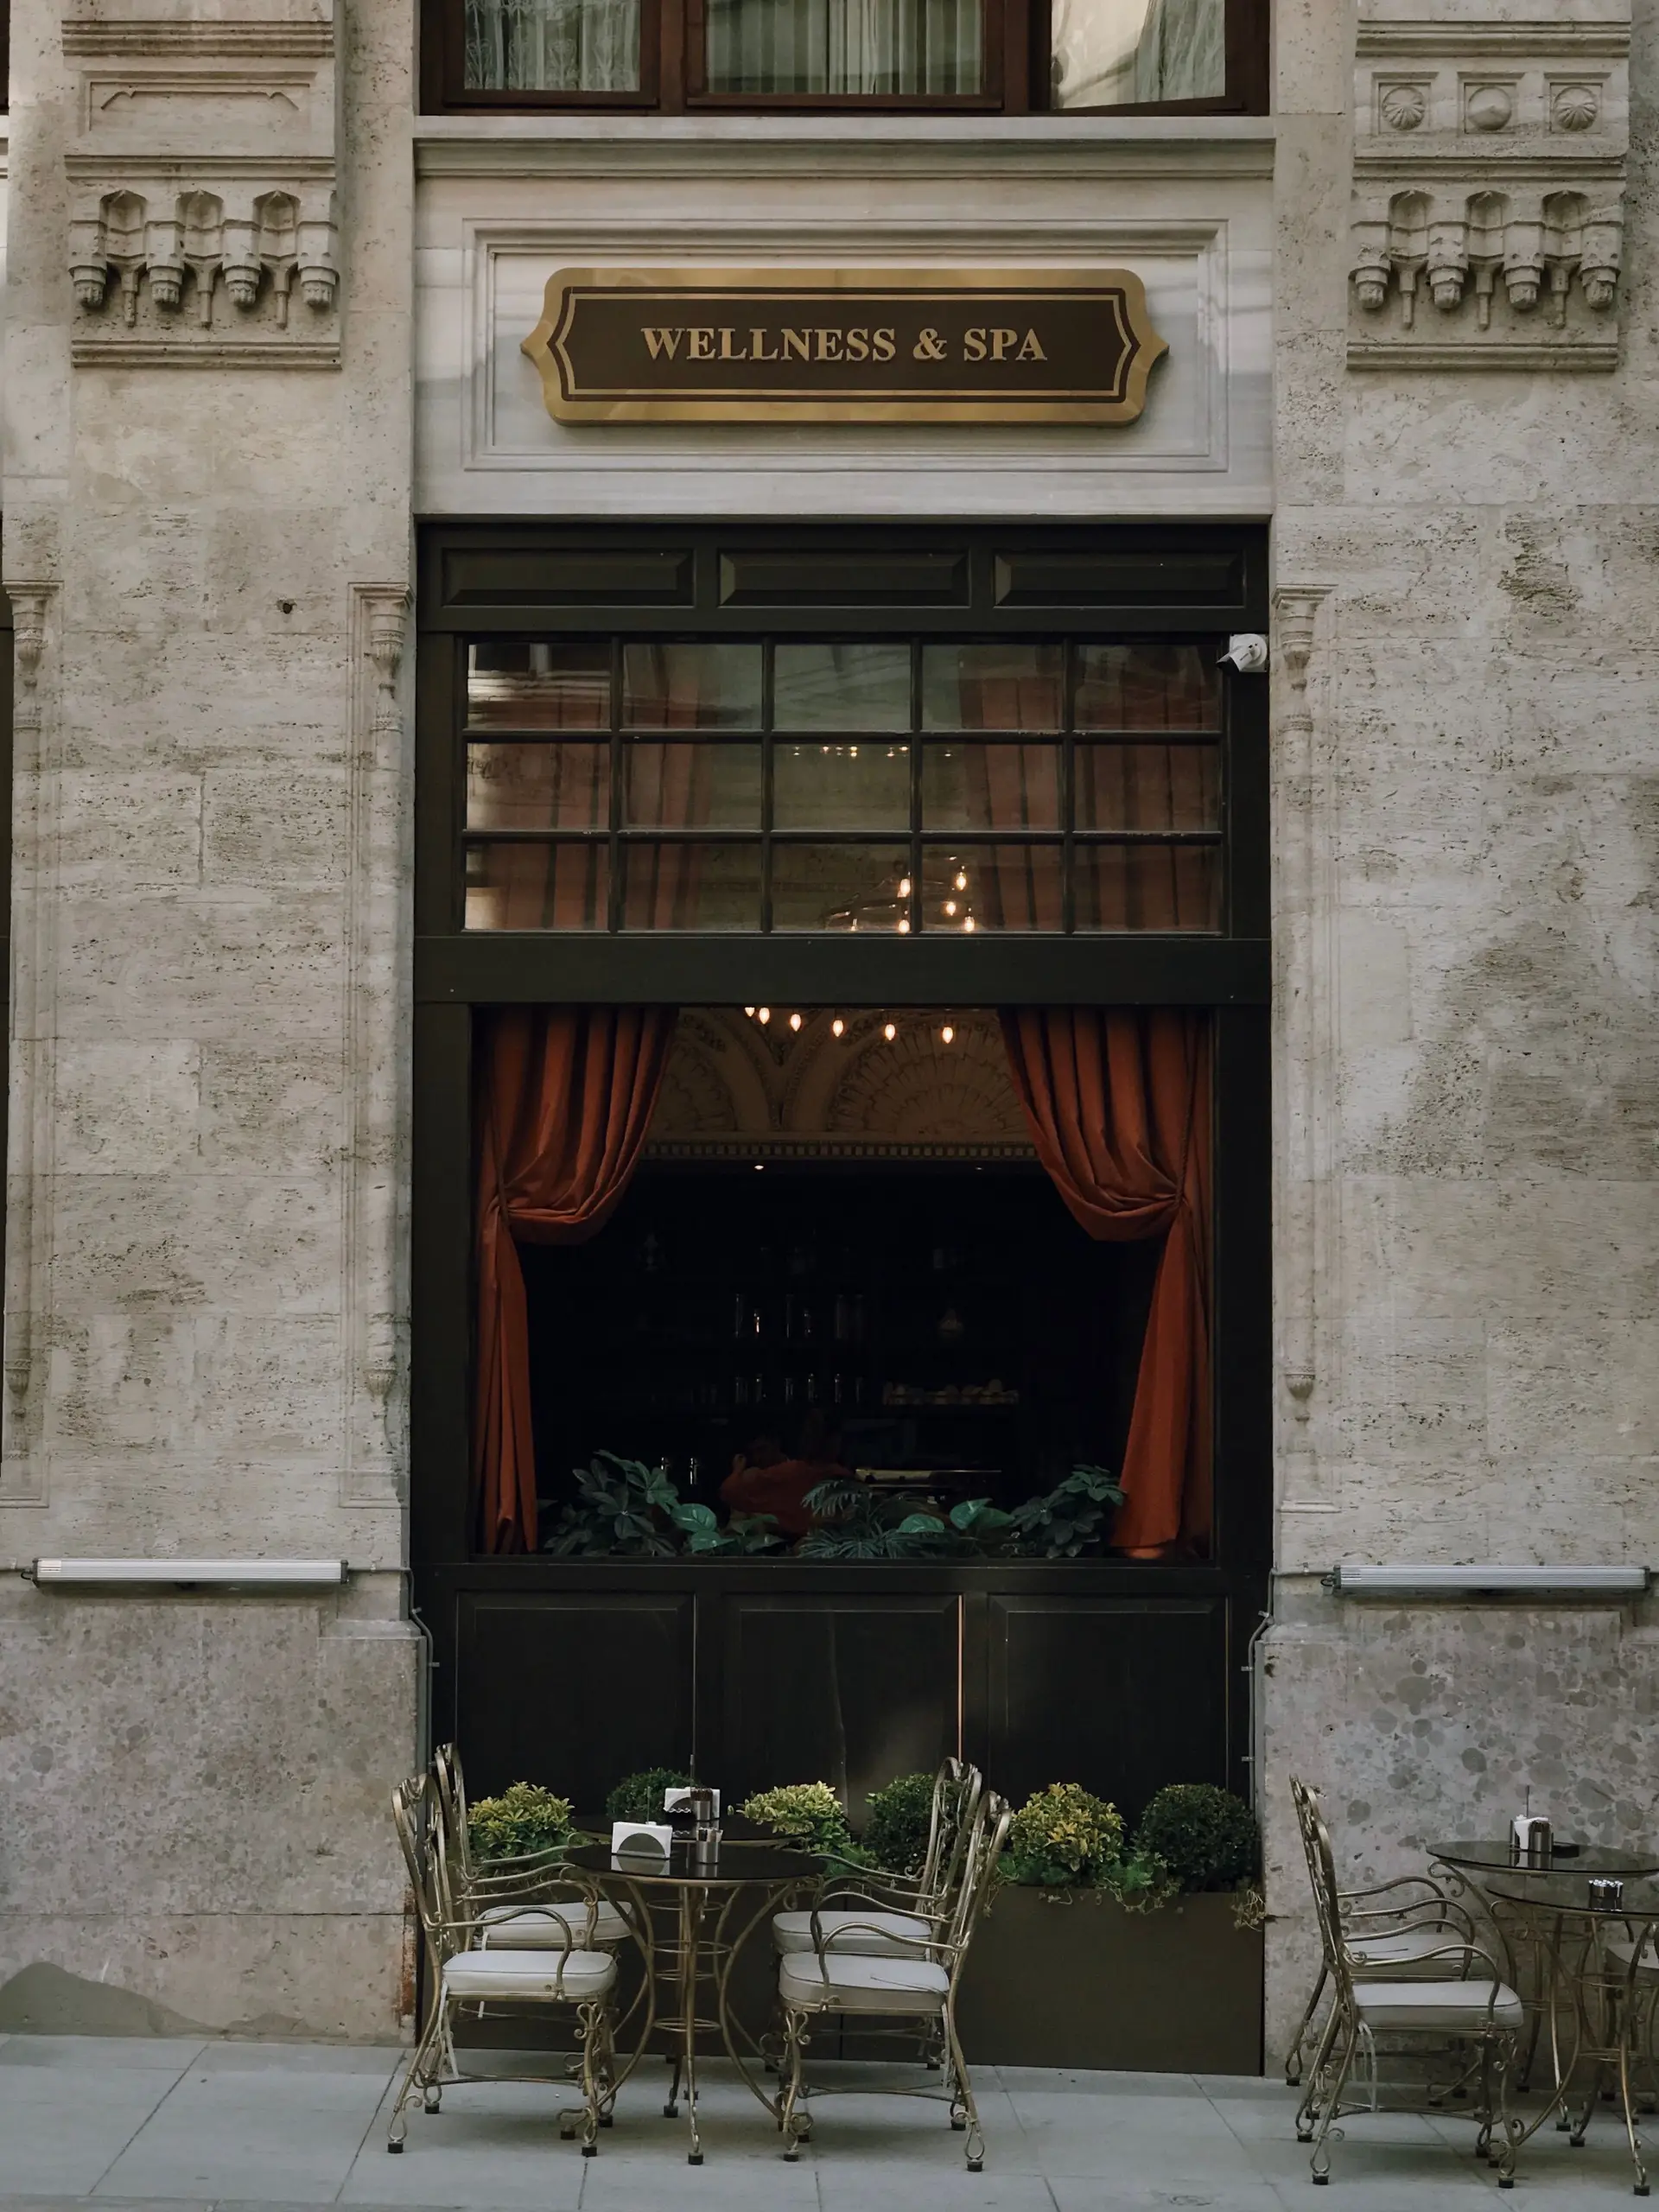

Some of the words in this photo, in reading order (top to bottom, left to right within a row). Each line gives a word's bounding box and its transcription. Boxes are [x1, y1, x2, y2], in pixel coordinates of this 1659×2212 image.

[640, 327, 896, 361] WELLNESS
[912, 327, 947, 360] &
[963, 327, 1048, 361] SPA
